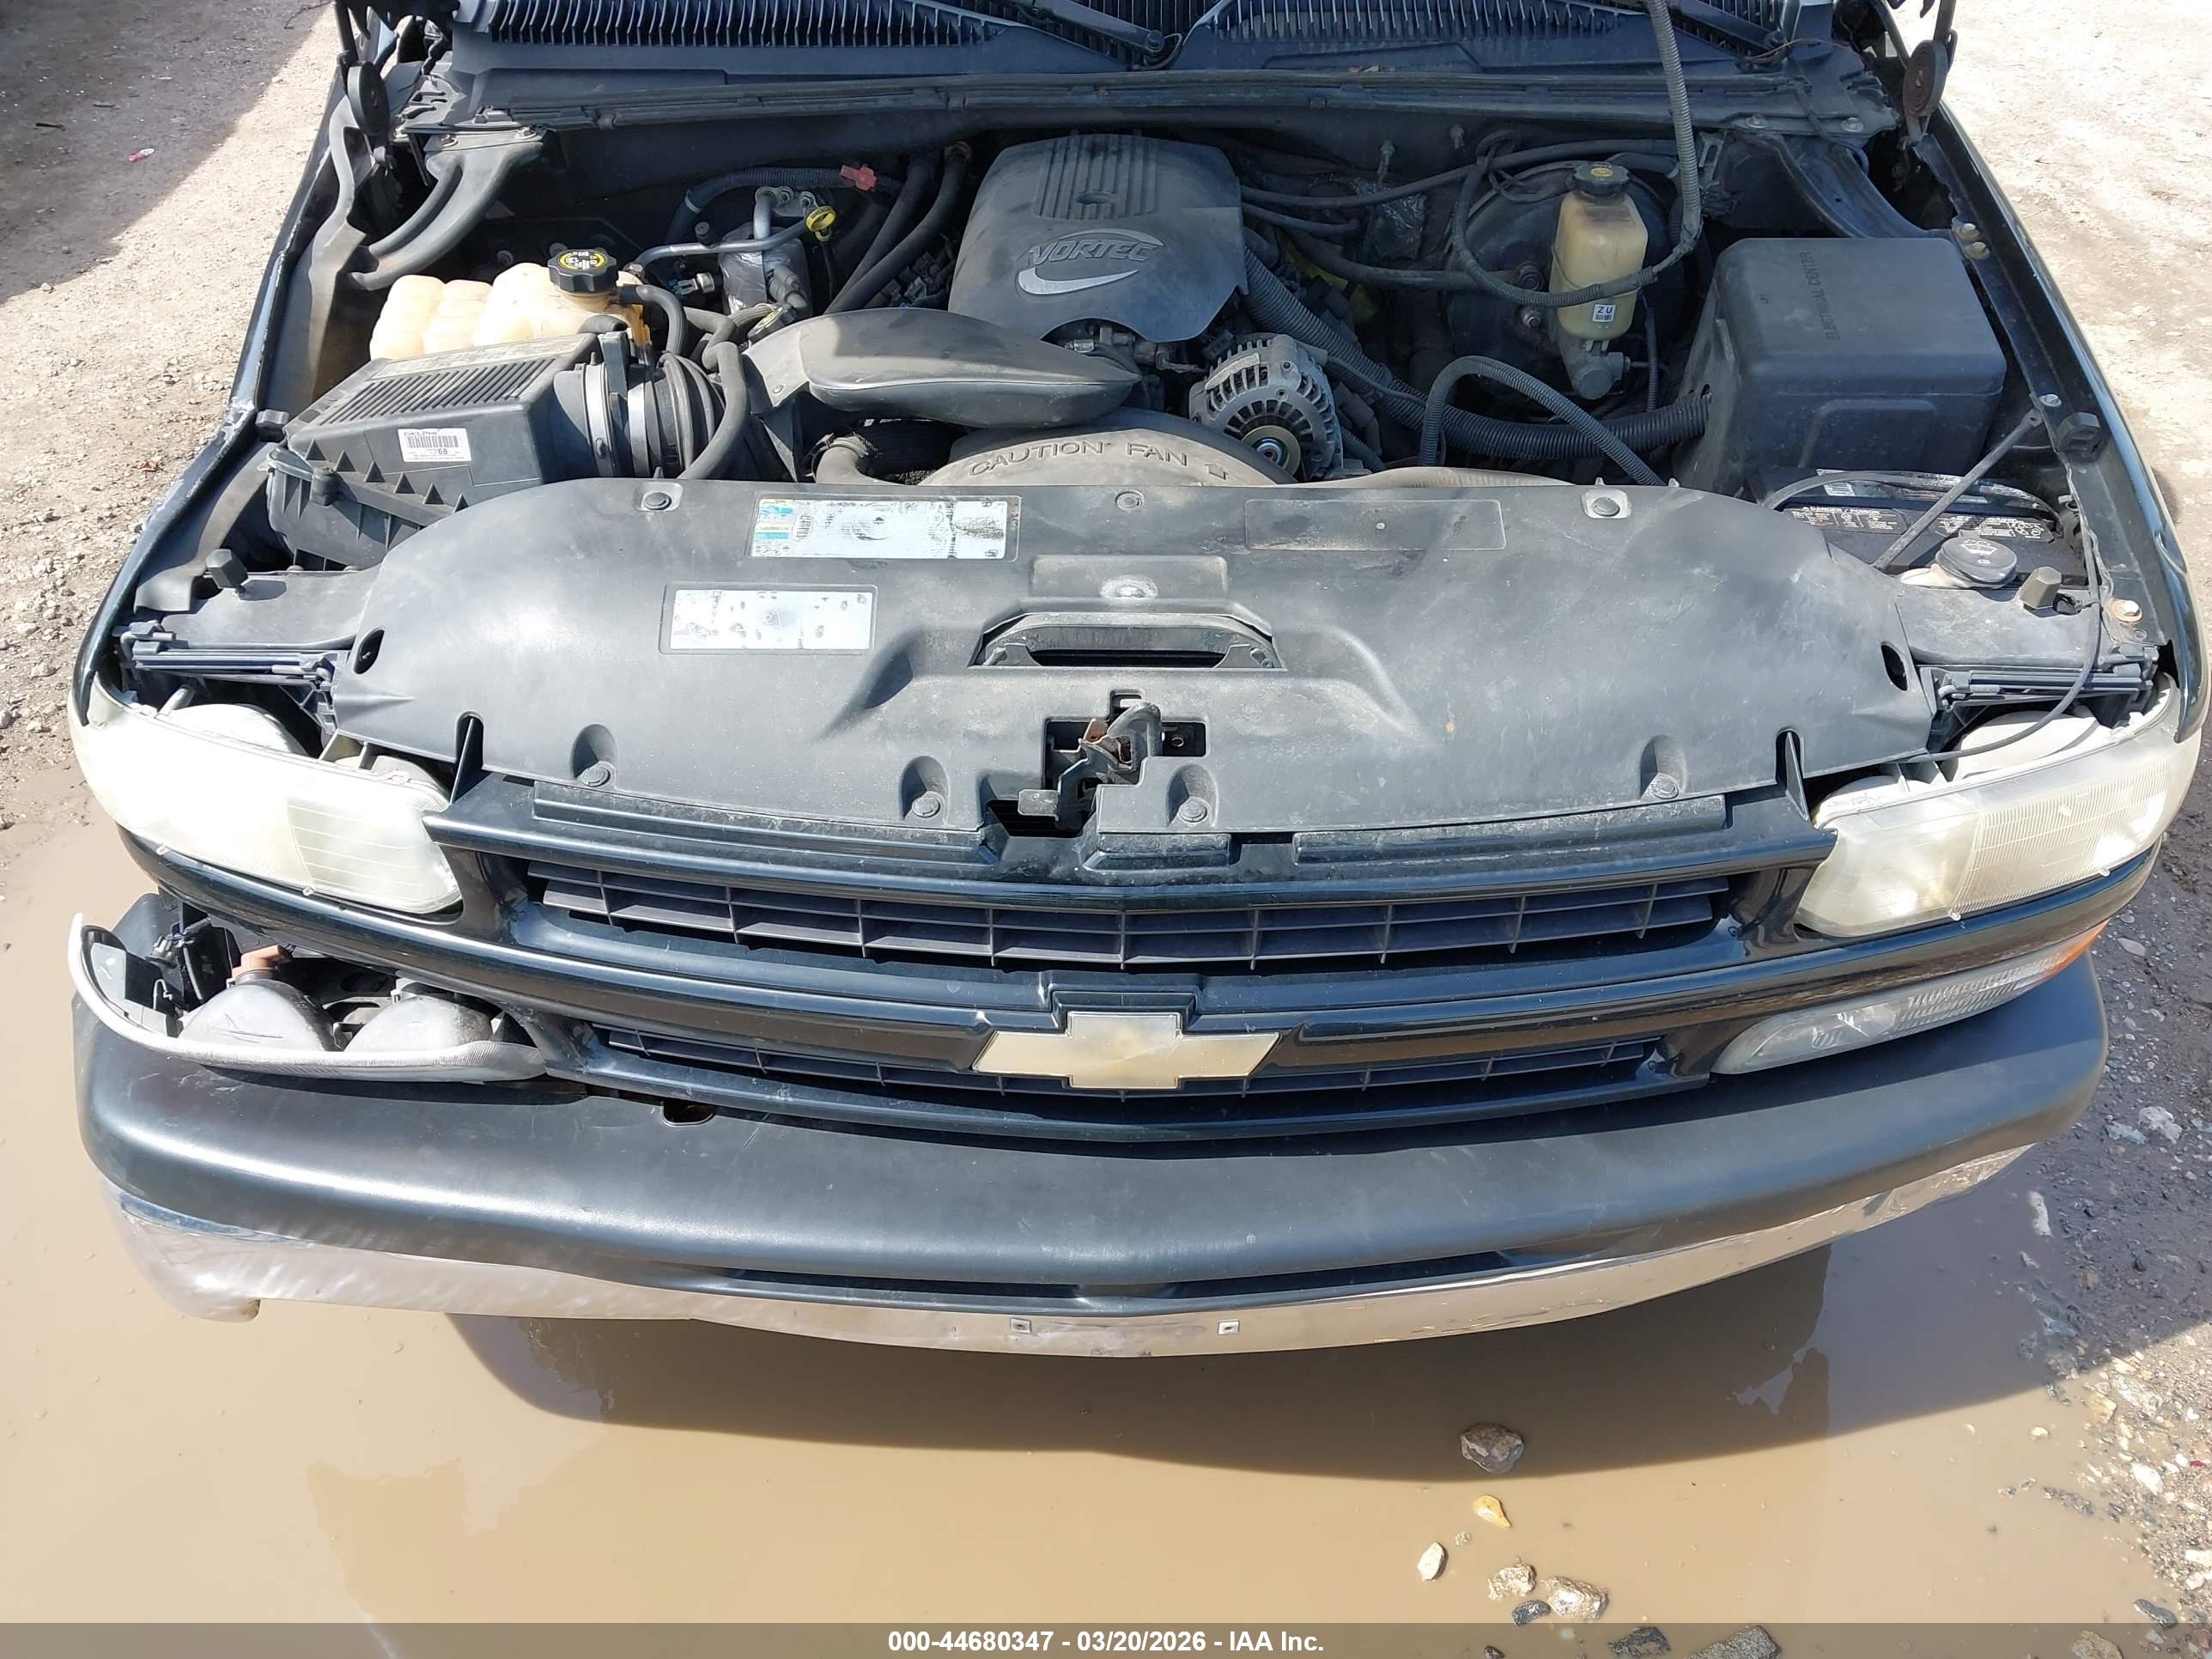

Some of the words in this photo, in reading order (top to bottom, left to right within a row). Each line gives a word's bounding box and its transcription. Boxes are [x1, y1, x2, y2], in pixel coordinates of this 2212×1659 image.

[1030, 240, 1159, 265] VORTEC
[969, 440, 1104, 477] CAUTION
[1126, 441, 1188, 467] FAN
